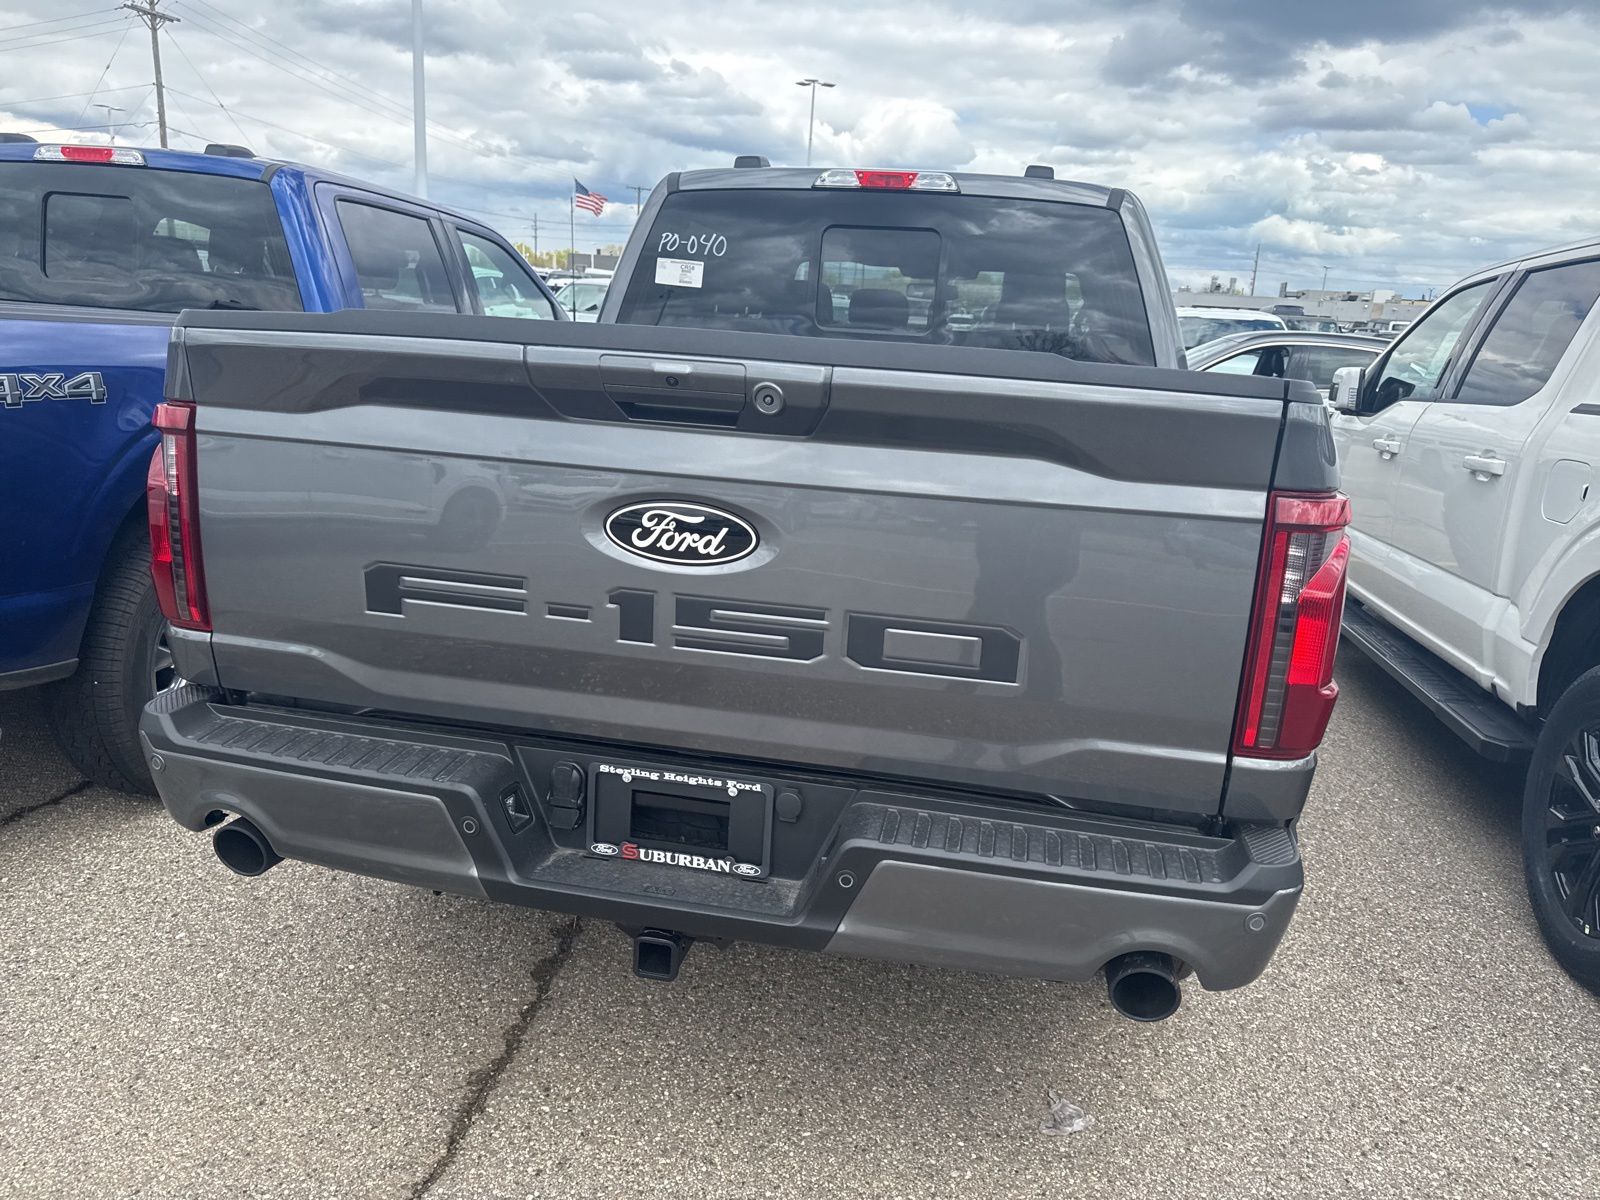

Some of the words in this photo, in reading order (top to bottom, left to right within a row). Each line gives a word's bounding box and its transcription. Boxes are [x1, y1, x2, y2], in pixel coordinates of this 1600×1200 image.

[631, 509, 730, 556] Ford
[363, 561, 1022, 686] F-150
[599, 764, 660, 780] Sterling
[663, 772, 722, 787] Heights
[727, 780, 762, 792] Ford
[621, 841, 730, 873] SUBURBAN
